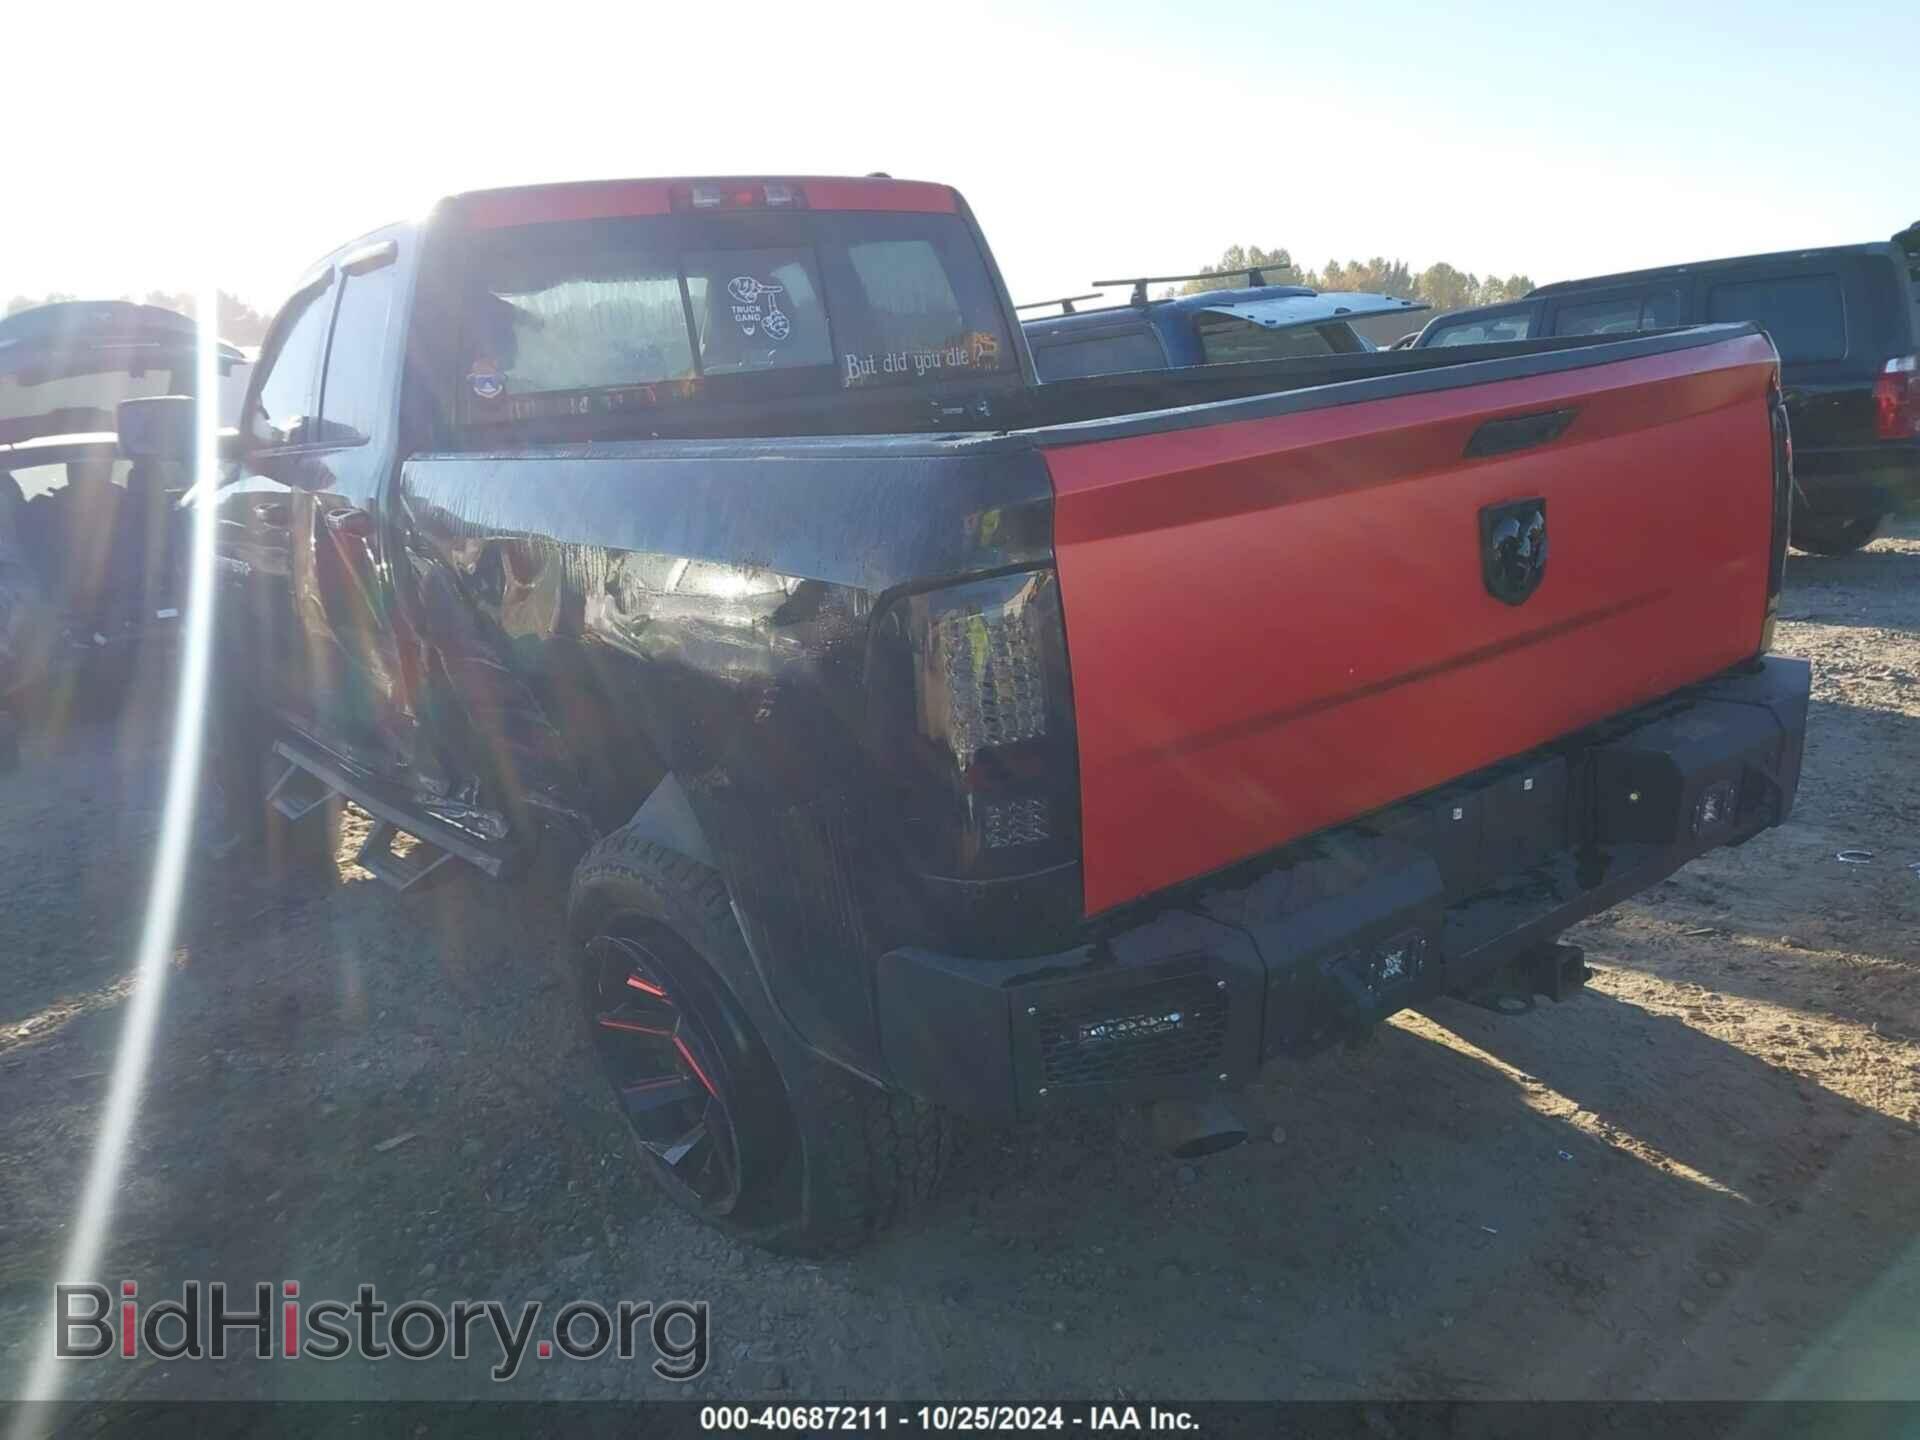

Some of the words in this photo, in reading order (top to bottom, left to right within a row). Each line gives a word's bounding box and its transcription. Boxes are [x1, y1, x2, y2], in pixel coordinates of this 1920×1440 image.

[732, 304, 761, 313] TRUCK
[735, 313, 761, 322] GANG
[846, 352, 877, 384] But
[883, 352, 907, 373] did
[914, 349, 941, 376] you
